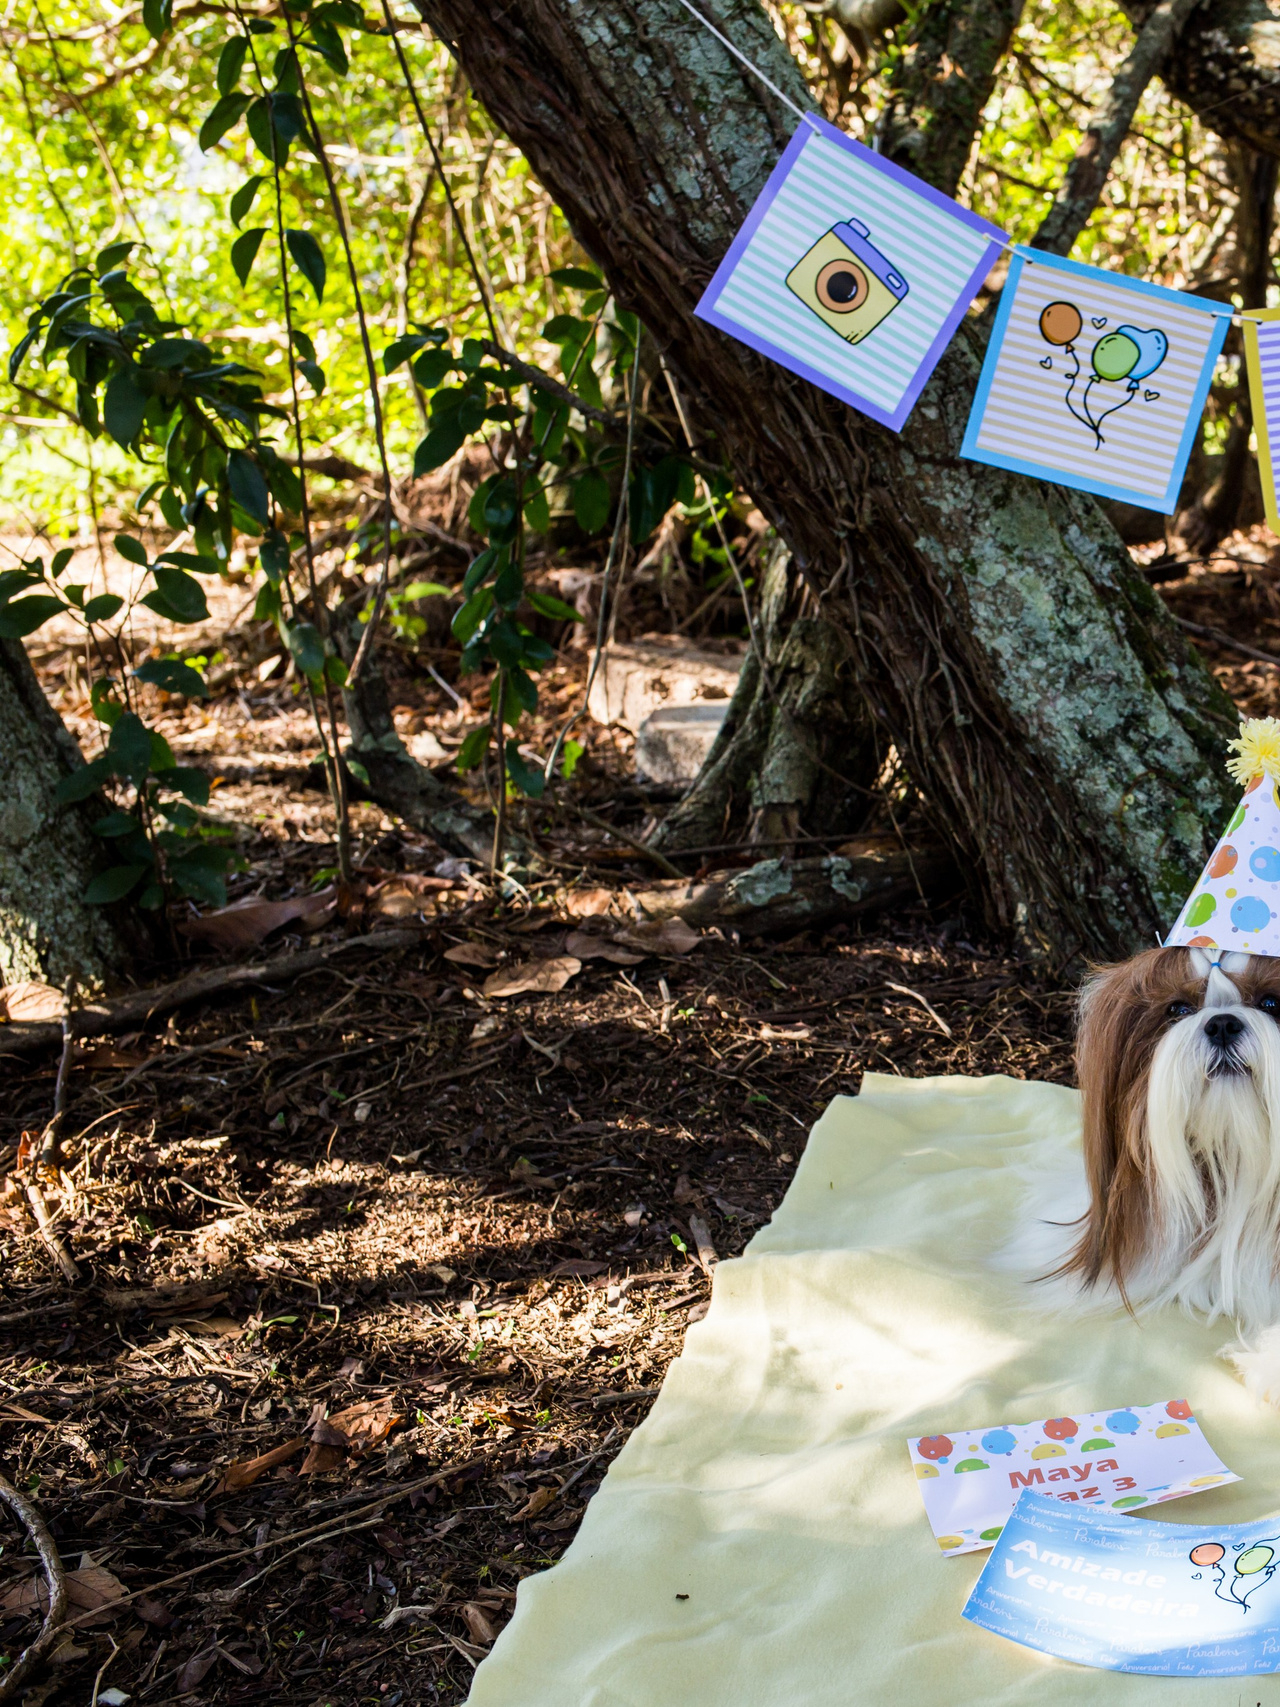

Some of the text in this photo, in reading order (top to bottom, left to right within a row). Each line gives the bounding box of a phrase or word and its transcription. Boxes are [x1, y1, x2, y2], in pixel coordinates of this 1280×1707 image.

[1008, 1458, 1120, 1489] Maya
[1112, 1476, 1137, 1492] 3
[1009, 1539, 1167, 1589] Amizade
[1005, 1558, 1199, 1618] Verdadeira
